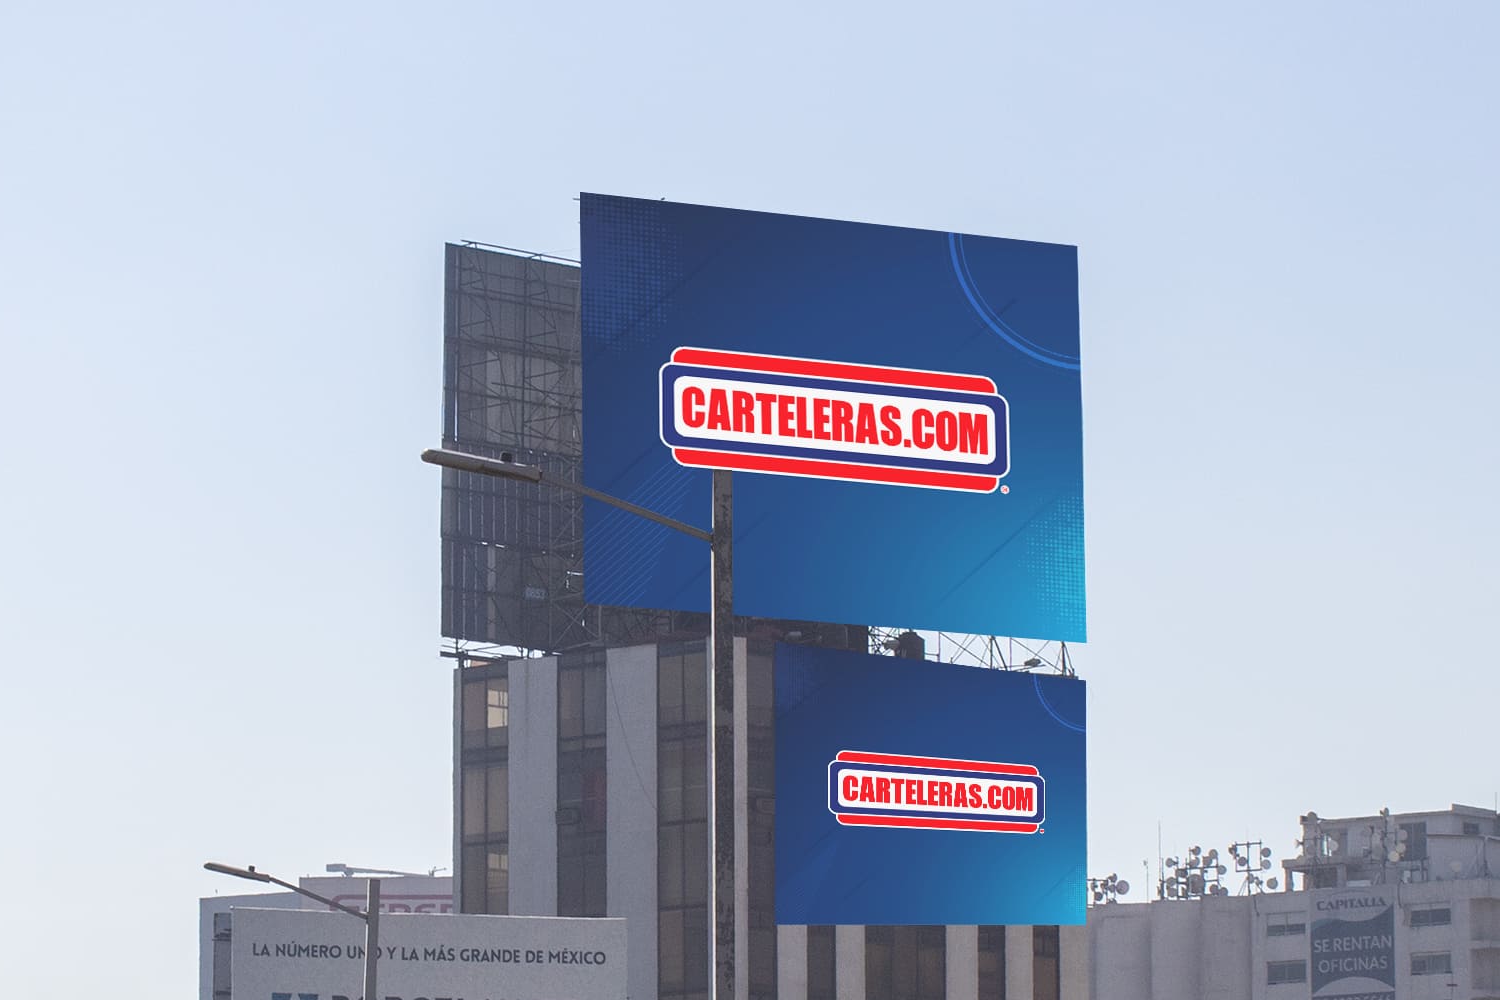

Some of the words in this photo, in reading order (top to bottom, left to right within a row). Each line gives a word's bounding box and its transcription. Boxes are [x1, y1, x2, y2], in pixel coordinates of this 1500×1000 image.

[682, 386, 988, 455] CARTELERAS.COM
[842, 775, 1034, 812] CARTELERAS.COM
[1316, 896, 1386, 912] CAPITALIA
[252, 943, 270, 957] LA
[275, 941, 342, 958] NÚMERO
[387, 947, 397, 960] Y
[401, 947, 419, 961] LA
[424, 945, 456, 962] MÁS
[460, 949, 520, 963] GRANDE
[525, 950, 544, 963] DE
[548, 947, 606, 965] MÉXICO
[1314, 939, 1330, 953] SE
[1333, 935, 1392, 952] RENTAN
[1318, 955, 1388, 973] OFICINAS
